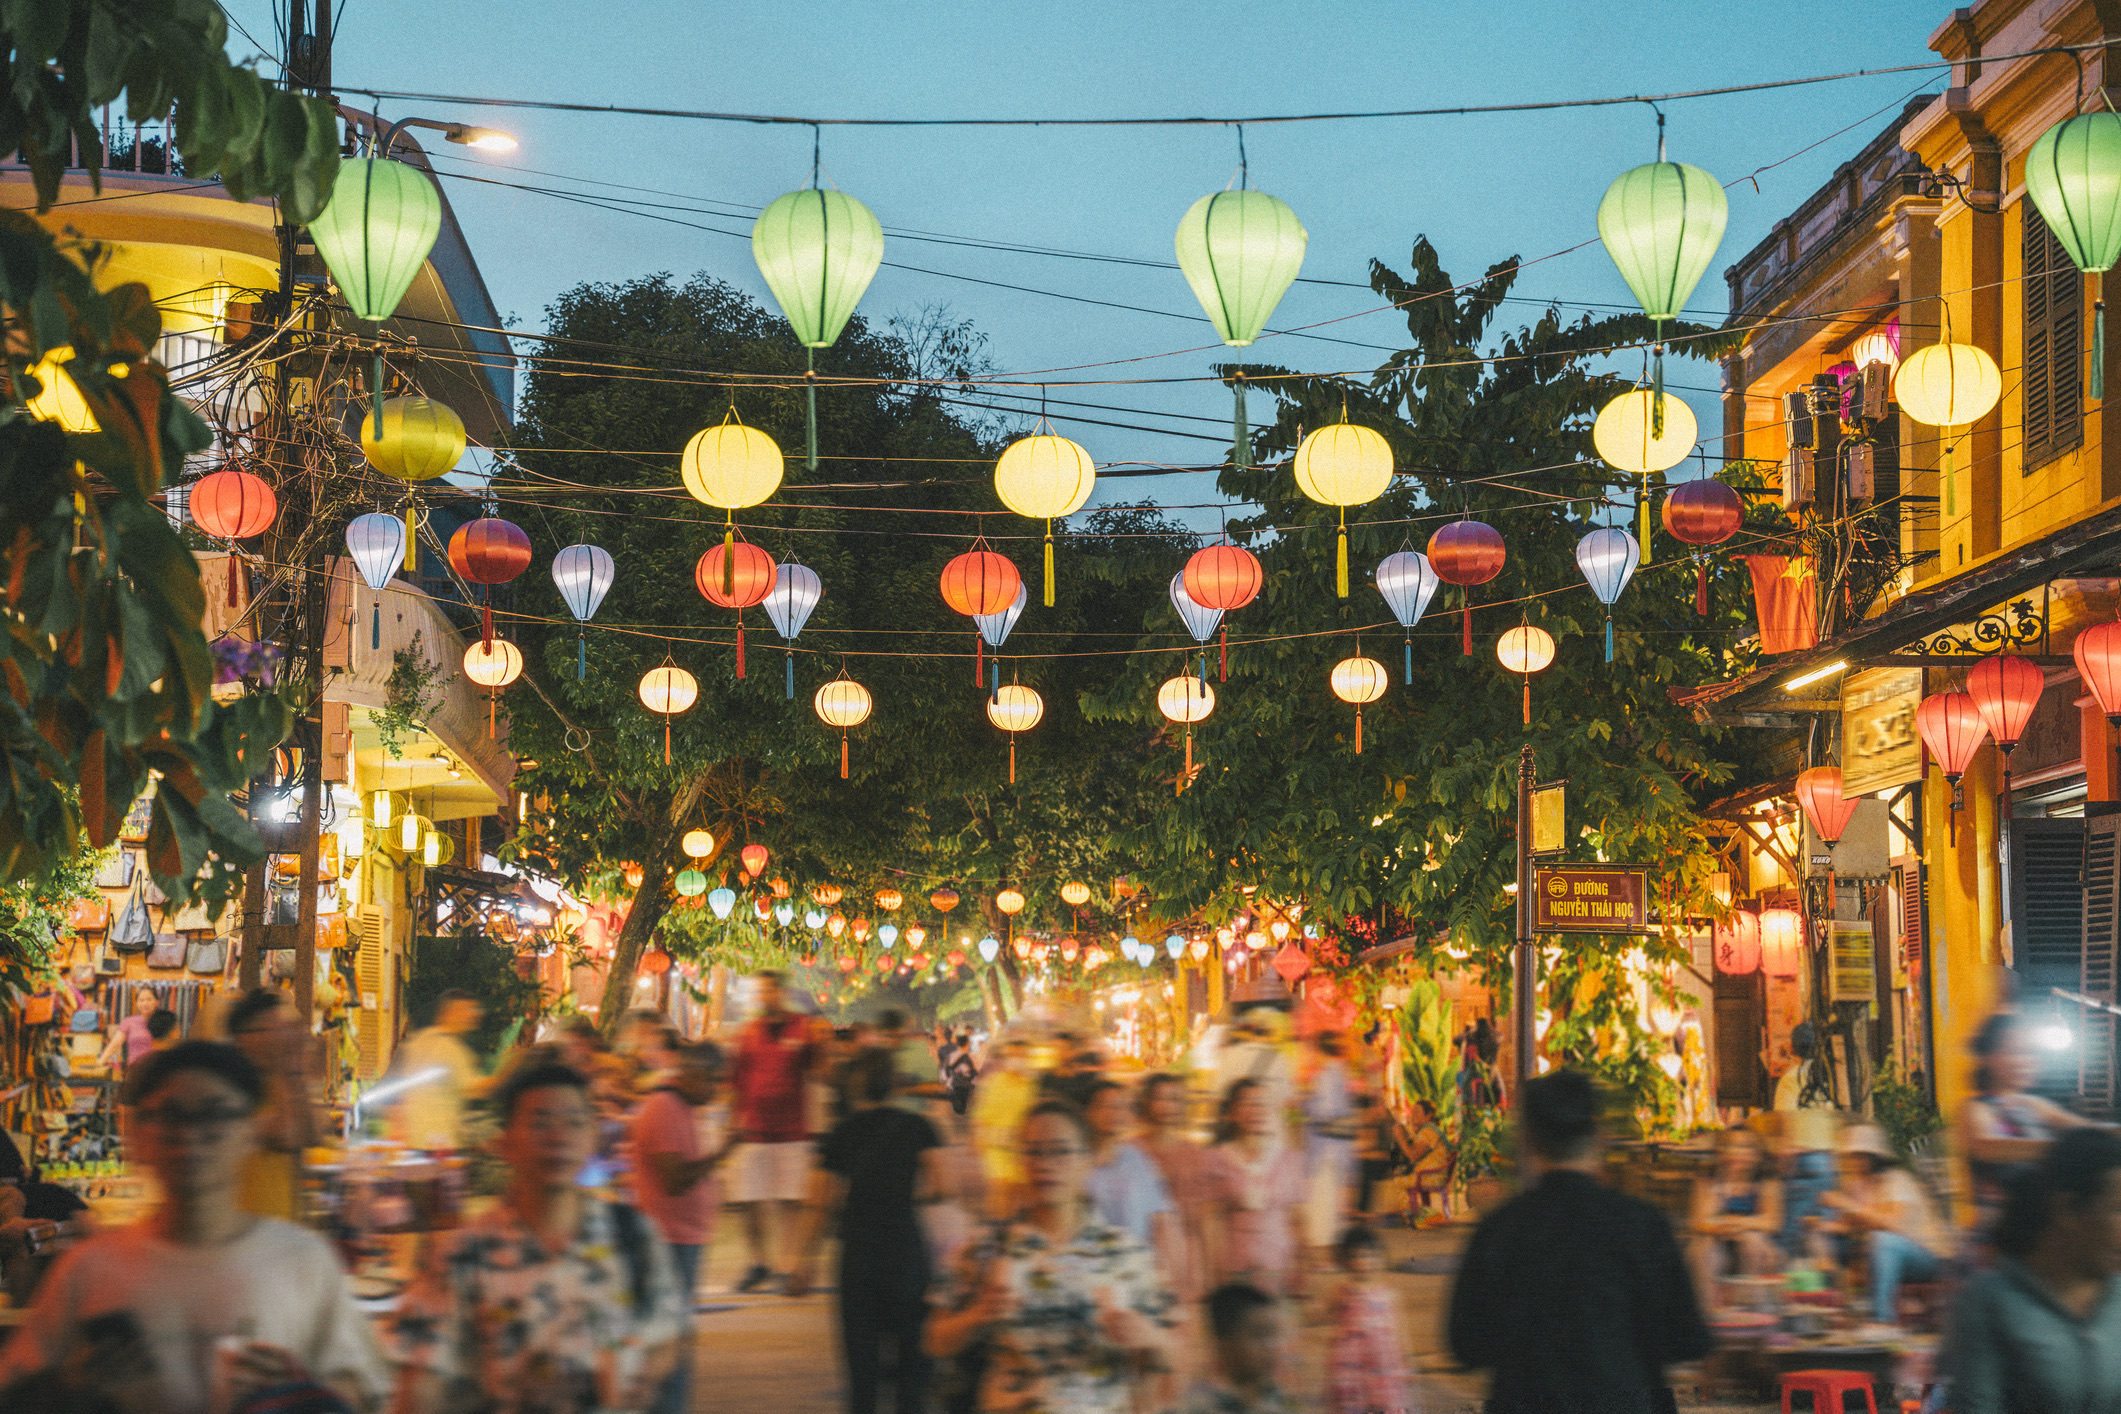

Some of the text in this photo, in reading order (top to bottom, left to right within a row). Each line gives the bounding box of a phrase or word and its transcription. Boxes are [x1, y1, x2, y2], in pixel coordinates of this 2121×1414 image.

[1573, 879, 1609, 896] ĐƯỜNG
[1550, 896, 1634, 920] NGUYỄN THÁI HỌC
